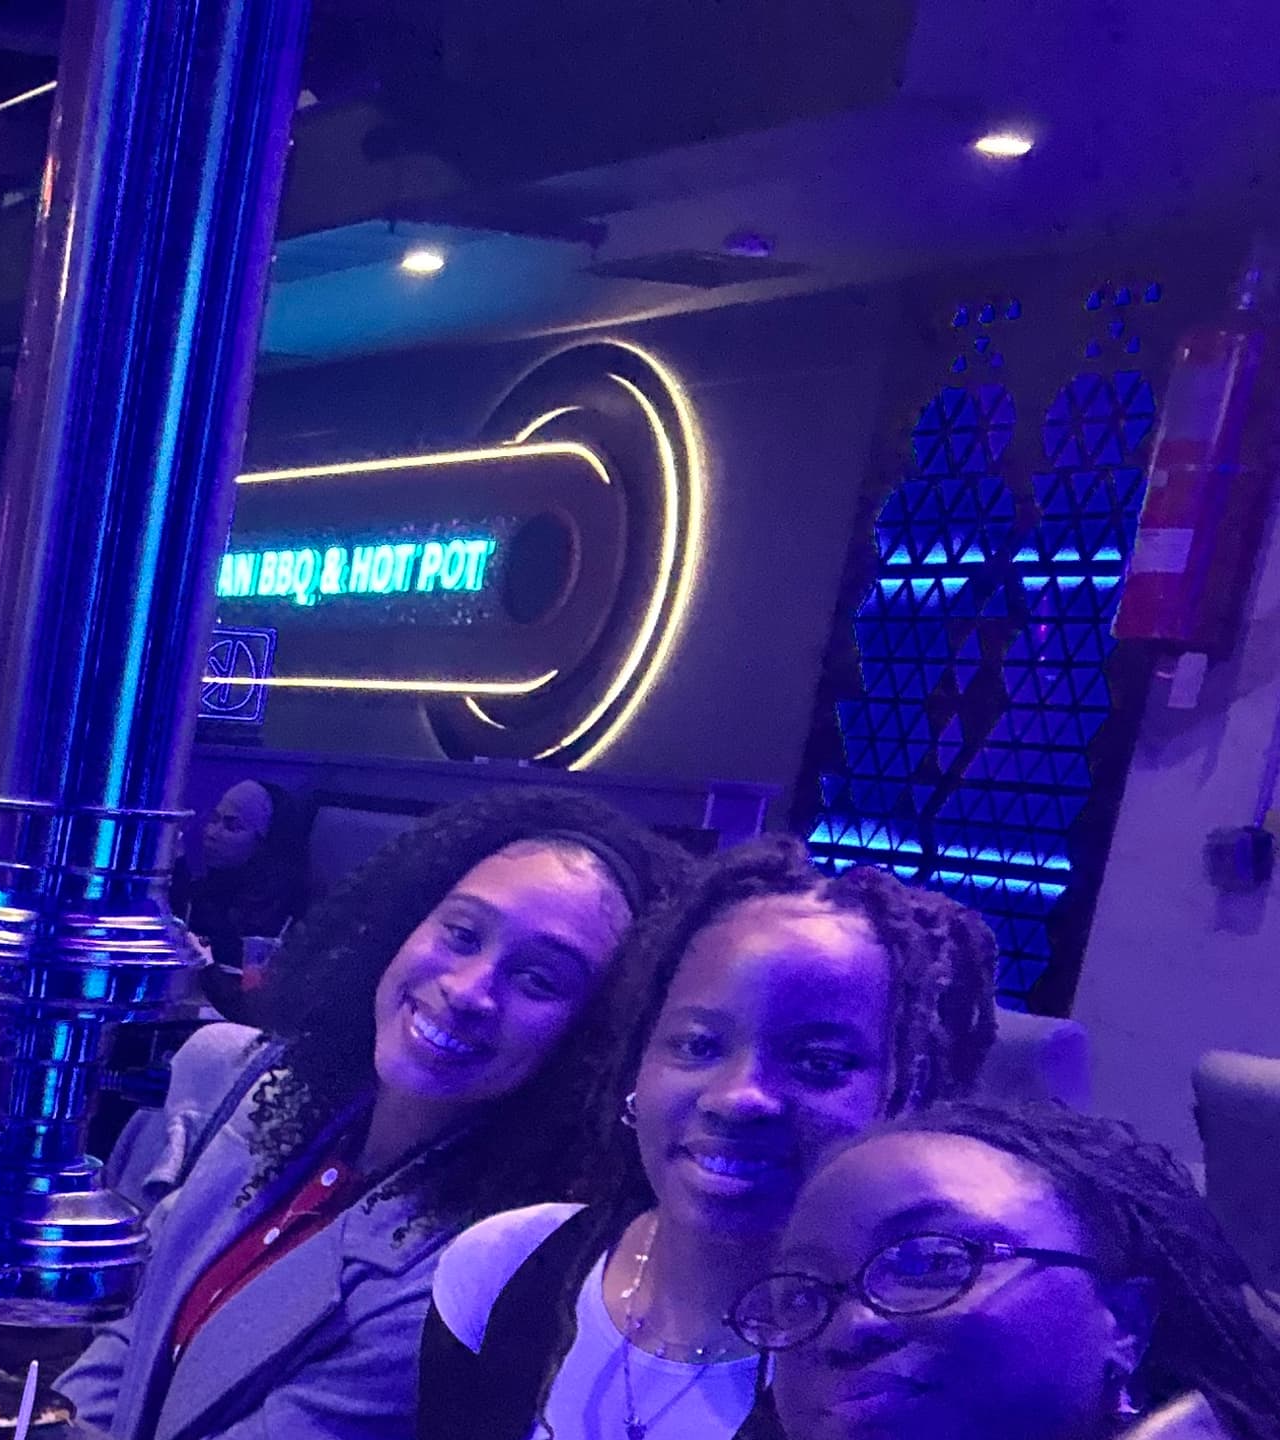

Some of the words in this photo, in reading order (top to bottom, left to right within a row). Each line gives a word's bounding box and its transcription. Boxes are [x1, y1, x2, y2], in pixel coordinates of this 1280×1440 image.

[258, 547, 322, 607] BBQ
[320, 546, 351, 595] &
[349, 543, 424, 594] HOT
[417, 538, 497, 592] POT
